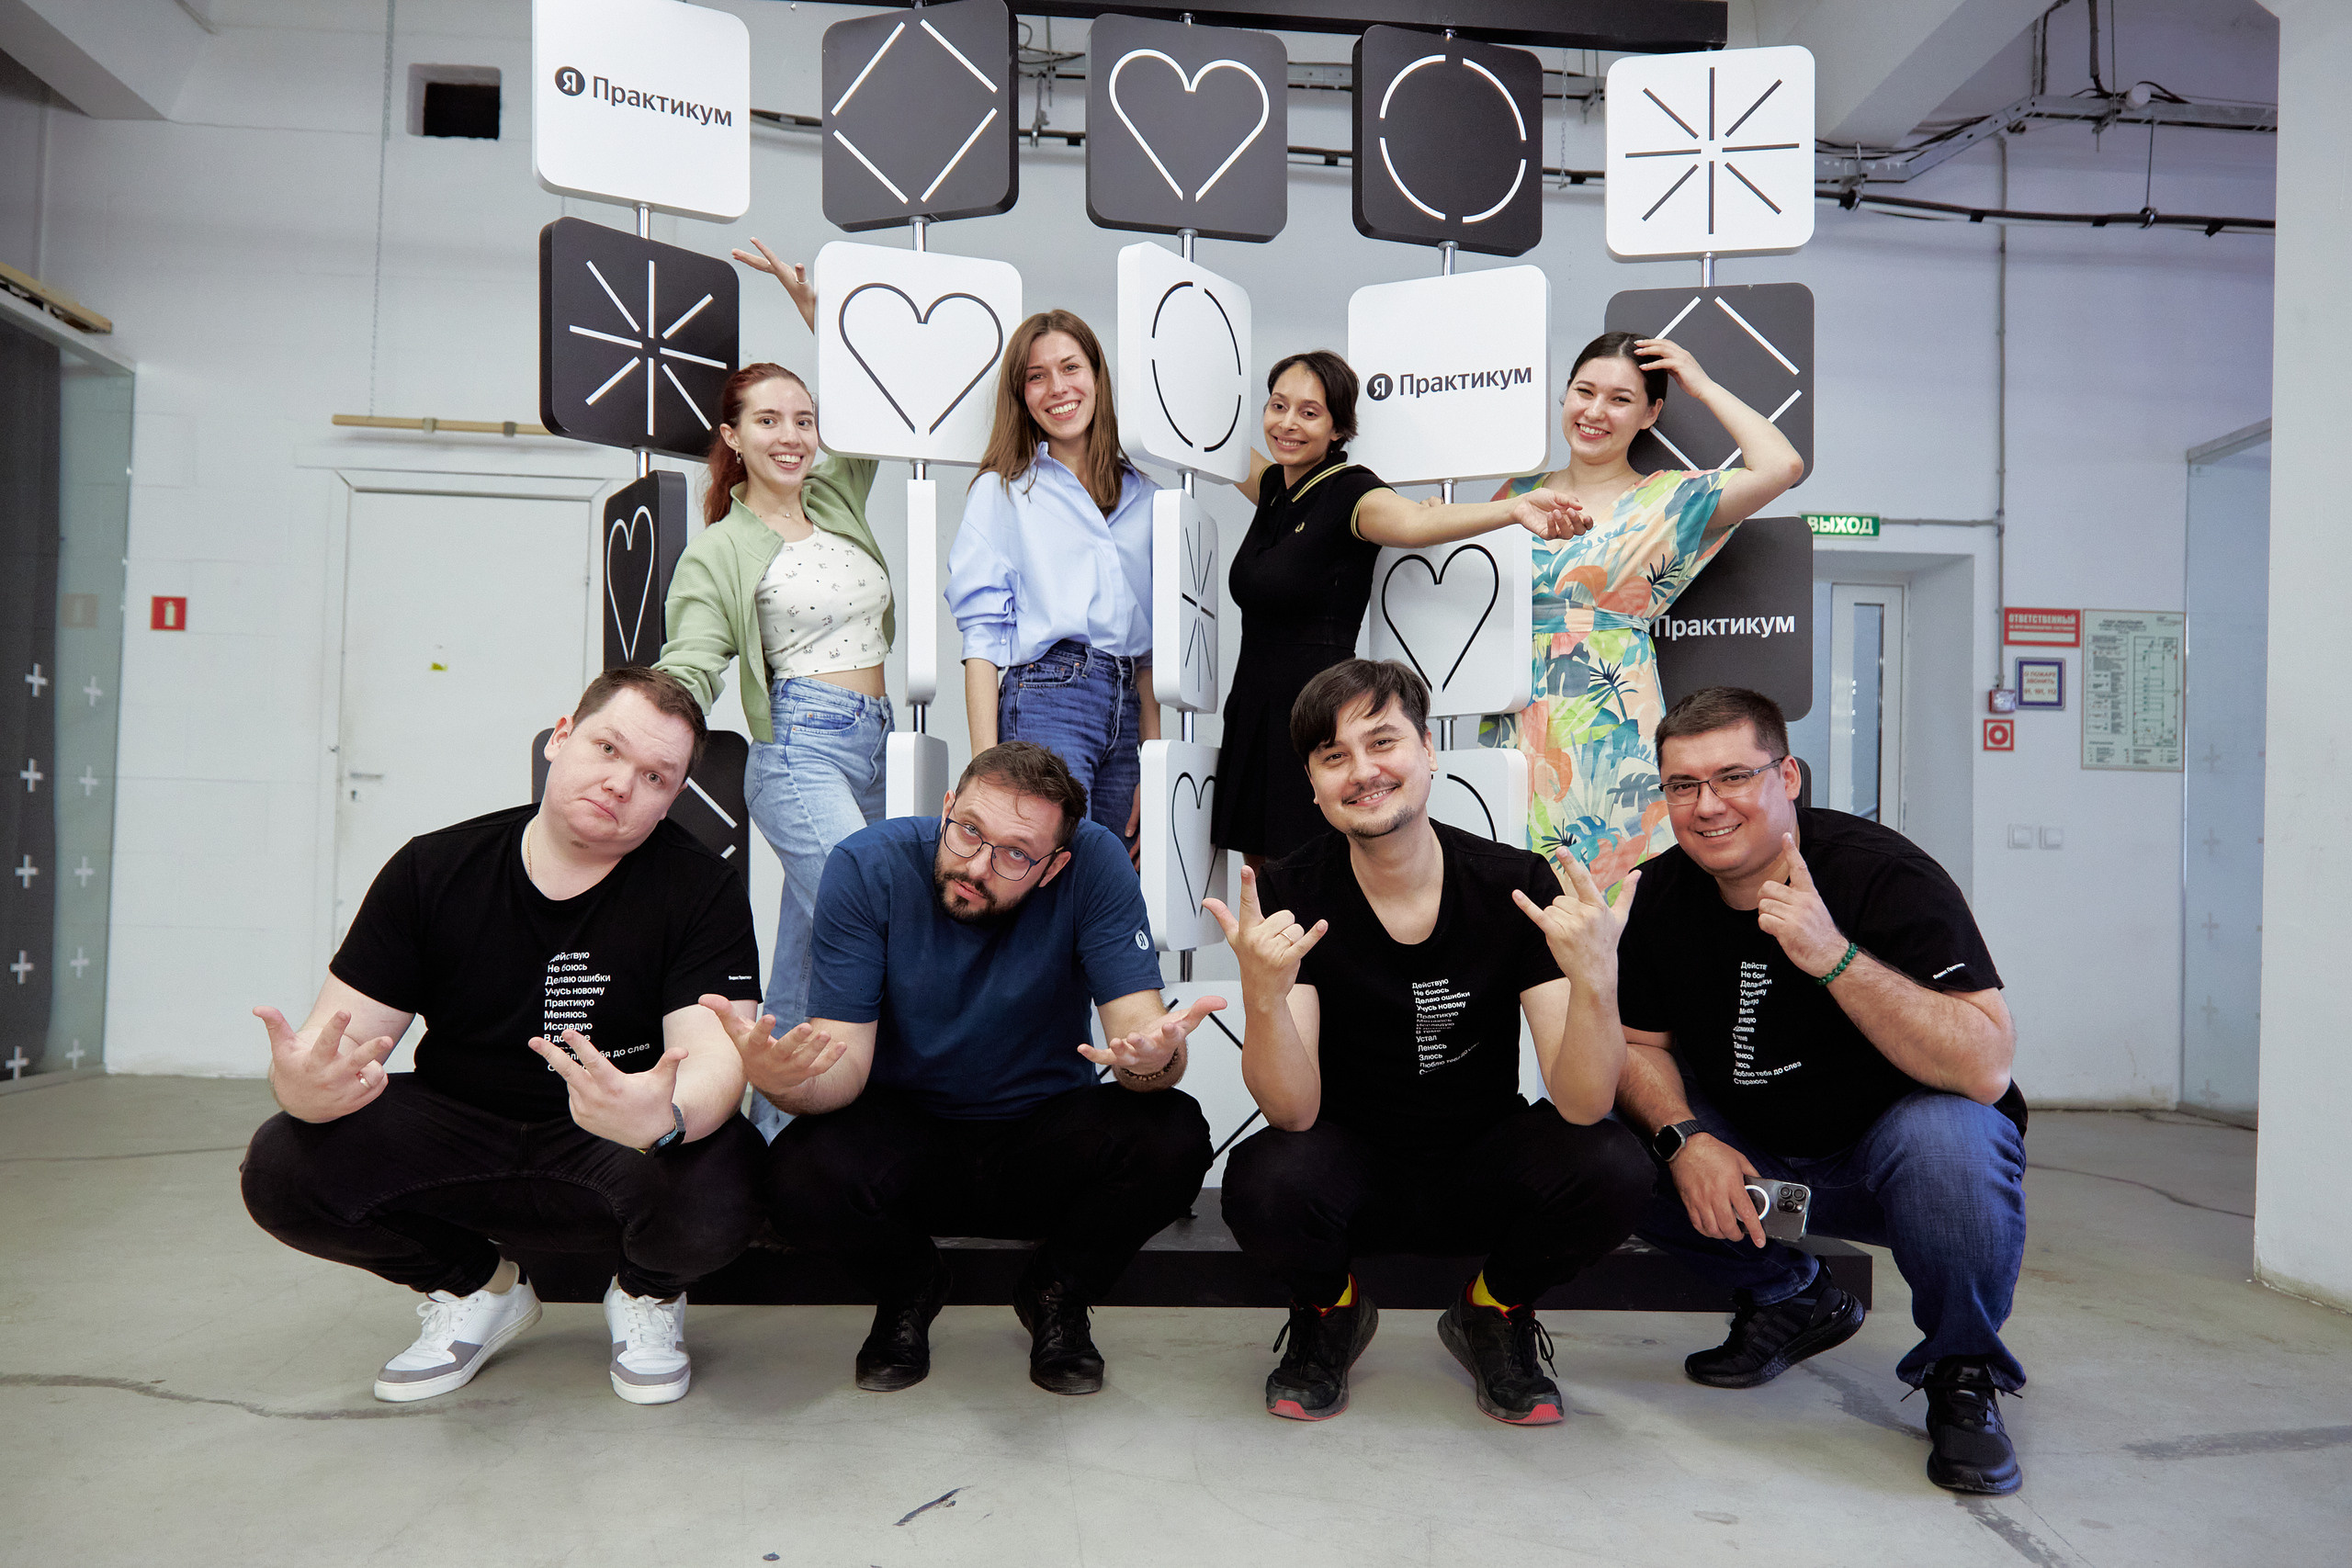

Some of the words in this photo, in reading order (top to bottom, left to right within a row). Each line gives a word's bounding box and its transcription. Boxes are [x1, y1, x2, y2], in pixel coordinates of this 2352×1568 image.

[594, 75, 731, 127] Практикум
[1399, 367, 1532, 398] Практикум
[1807, 515, 1874, 535] ВЫХОД
[2008, 613, 2076, 626] ОТВЕТСТВЕННЫЙ
[1655, 615, 1795, 641] Практикум
[548, 964, 560, 973] Не
[561, 964, 588, 972] боюсь
[545, 976, 576, 986] Делаю
[577, 974, 611, 983] ошибки
[1412, 979, 1449, 988] Действую
[545, 987, 571, 997] Учусь
[572, 987, 605, 996] новому
[1442, 992, 1470, 1000] ошибки
[544, 998, 594, 1009] Практикую
[1438, 1001, 1466, 1010] новому
[544, 1010, 588, 1019] Меняюсь
[544, 1022, 593, 1032] Исследую
[544, 1033, 551, 1042] В
[552, 1034, 591, 1043] дое
[613, 1050, 626, 1059] до
[628, 1043, 650, 1054] слез
[1418, 1043, 1448, 1053] Ленюсь
[1419, 1054, 1443, 1062] Злюсь
[1733, 1068, 1756, 1077] Люблю
[1773, 1067, 1784, 1076] до
[1783, 1061, 1803, 1072] слез
